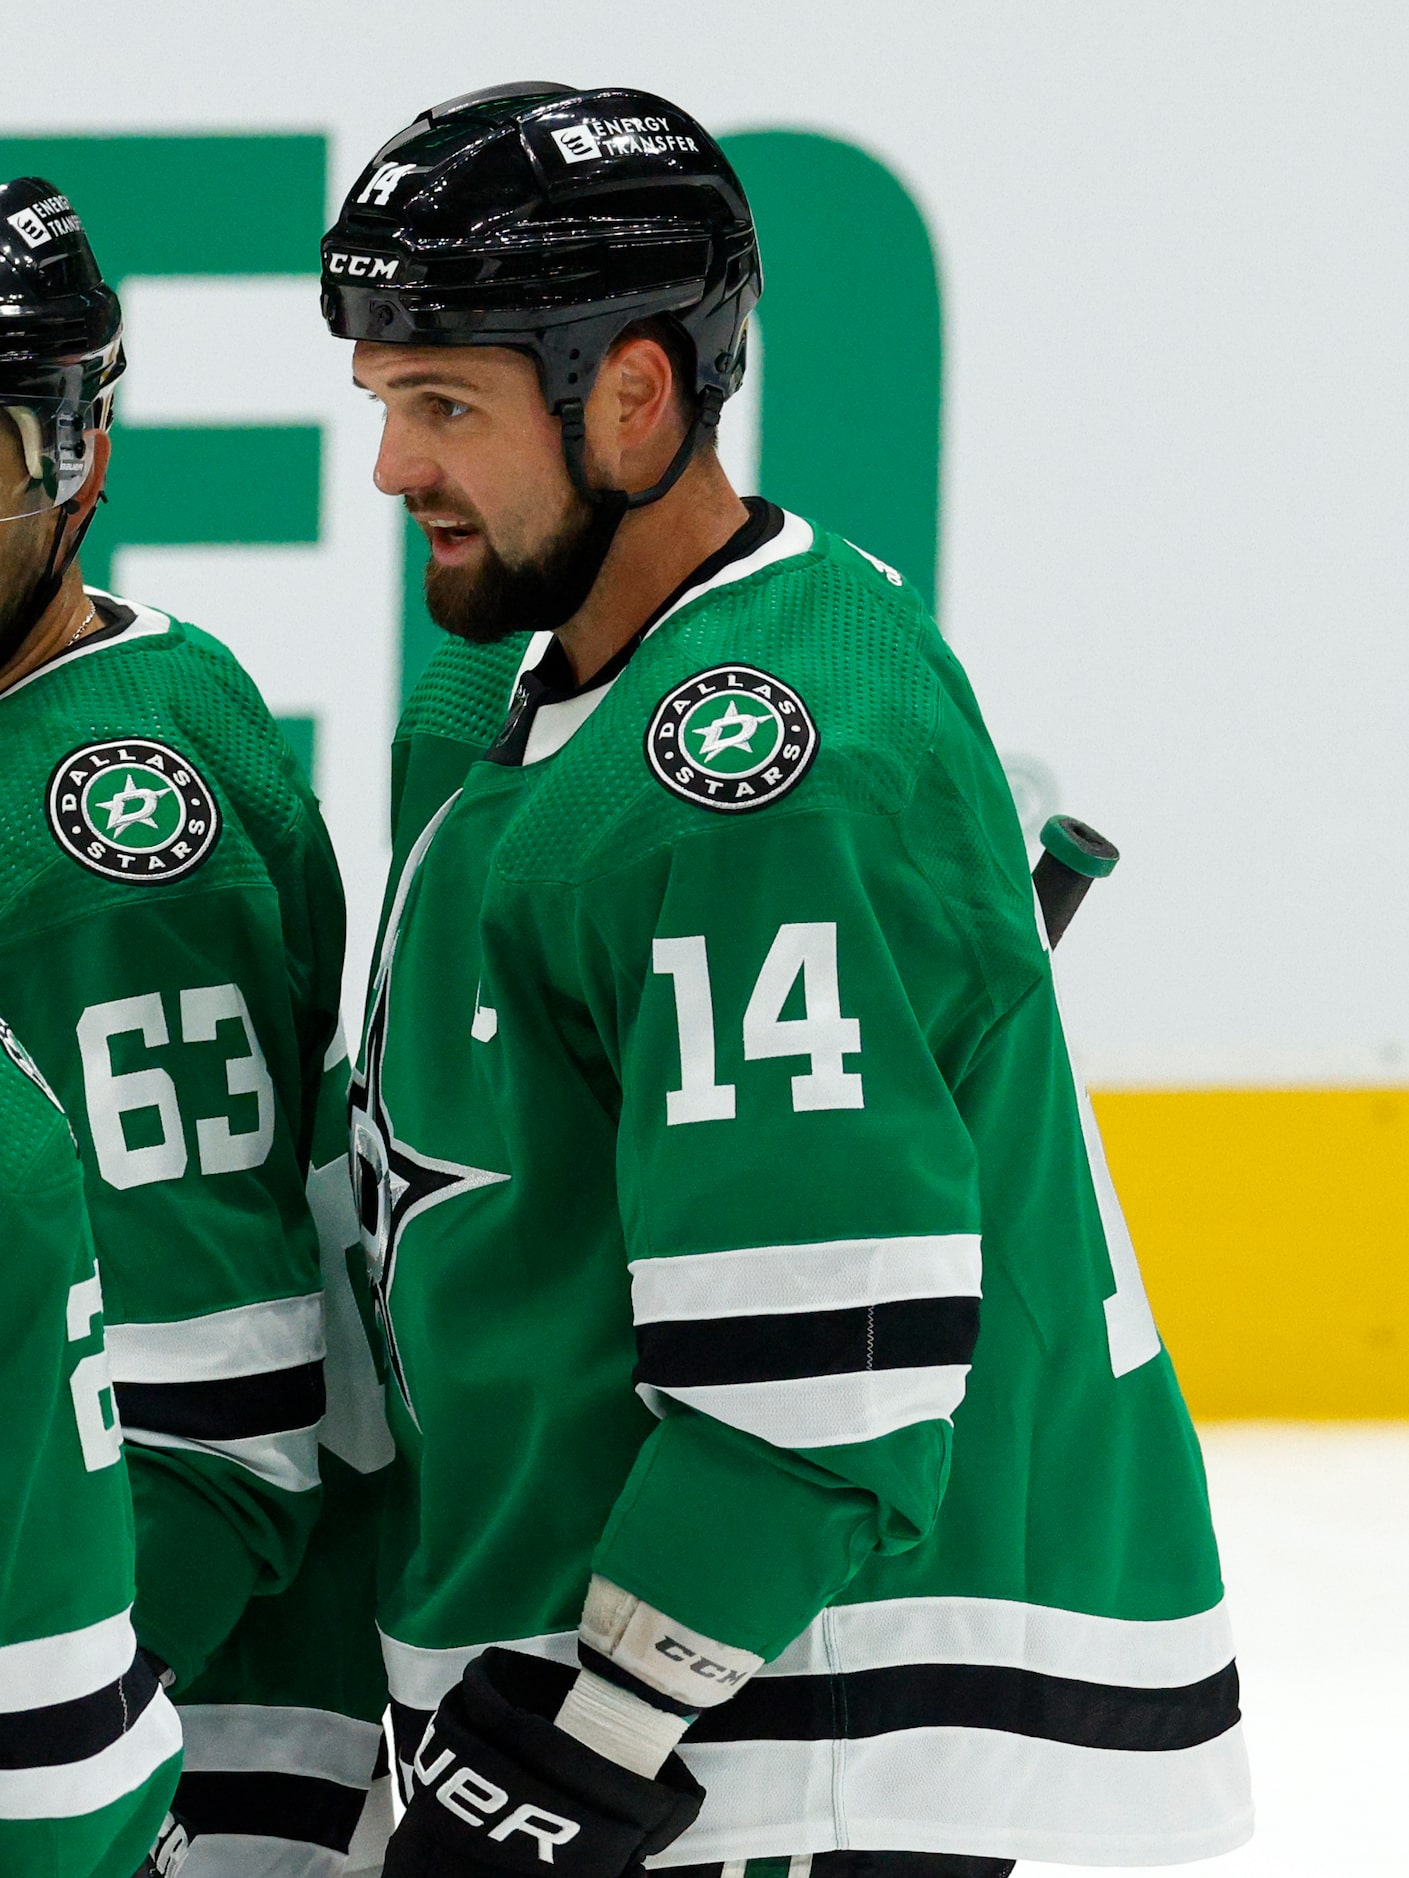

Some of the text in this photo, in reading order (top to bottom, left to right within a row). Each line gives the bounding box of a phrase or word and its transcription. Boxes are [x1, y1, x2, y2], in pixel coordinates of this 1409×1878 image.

[593, 117, 670, 137] ENERGY
[603, 135, 699, 156] TRANSFER
[357, 162, 417, 205] 14
[330, 253, 399, 279] CCM
[659, 673, 796, 740] DALLAS
[62, 749, 191, 814] DALLAS
[676, 744, 800, 798] STARS
[87, 819, 205, 870] STARS
[652, 922, 865, 1126] 14
[76, 983, 275, 1190] 63
[654, 1635, 748, 1687] CCM
